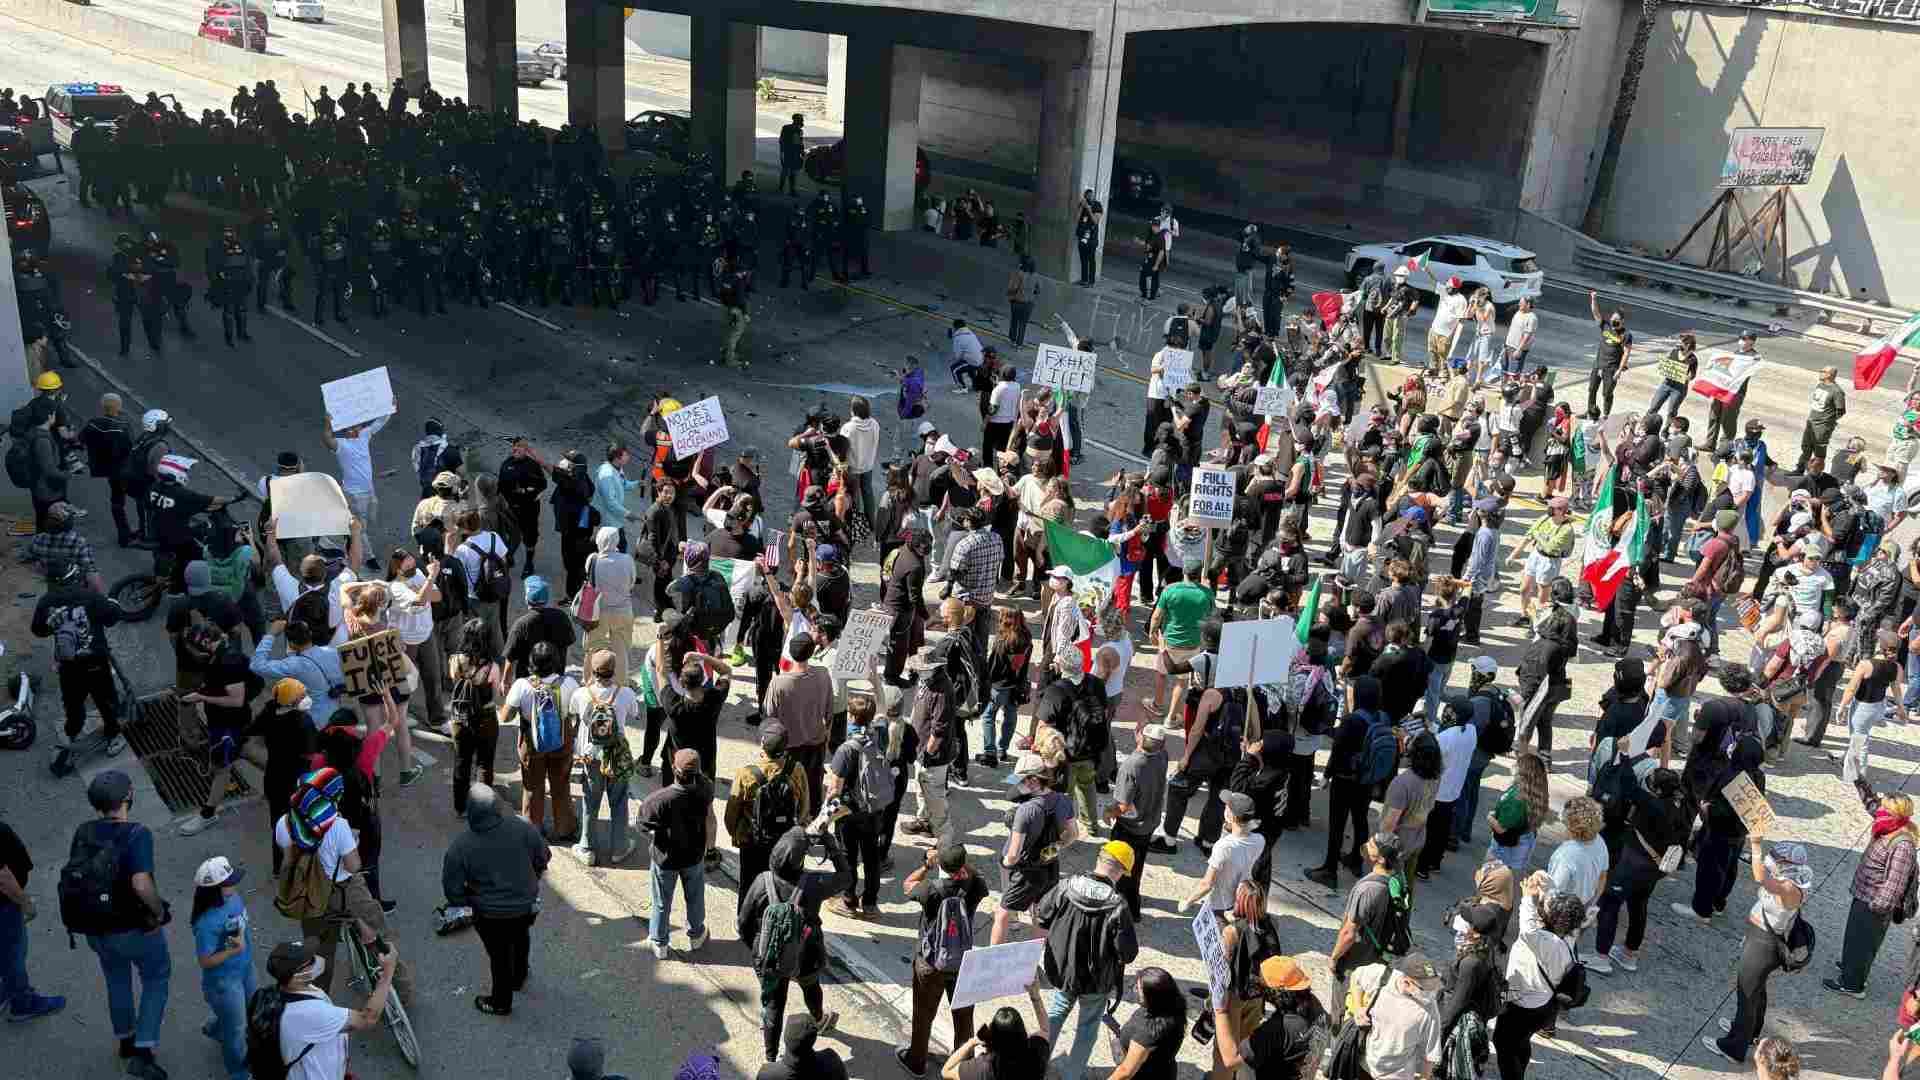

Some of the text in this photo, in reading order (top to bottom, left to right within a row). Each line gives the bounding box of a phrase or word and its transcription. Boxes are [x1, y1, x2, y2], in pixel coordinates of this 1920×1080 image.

[1202, 471, 1227, 485] FULL
[1194, 484, 1233, 497] RIGHTS
[1193, 499, 1233, 512] FOR ALL
[341, 636, 399, 665] FUCK
[345, 654, 402, 695] IE
